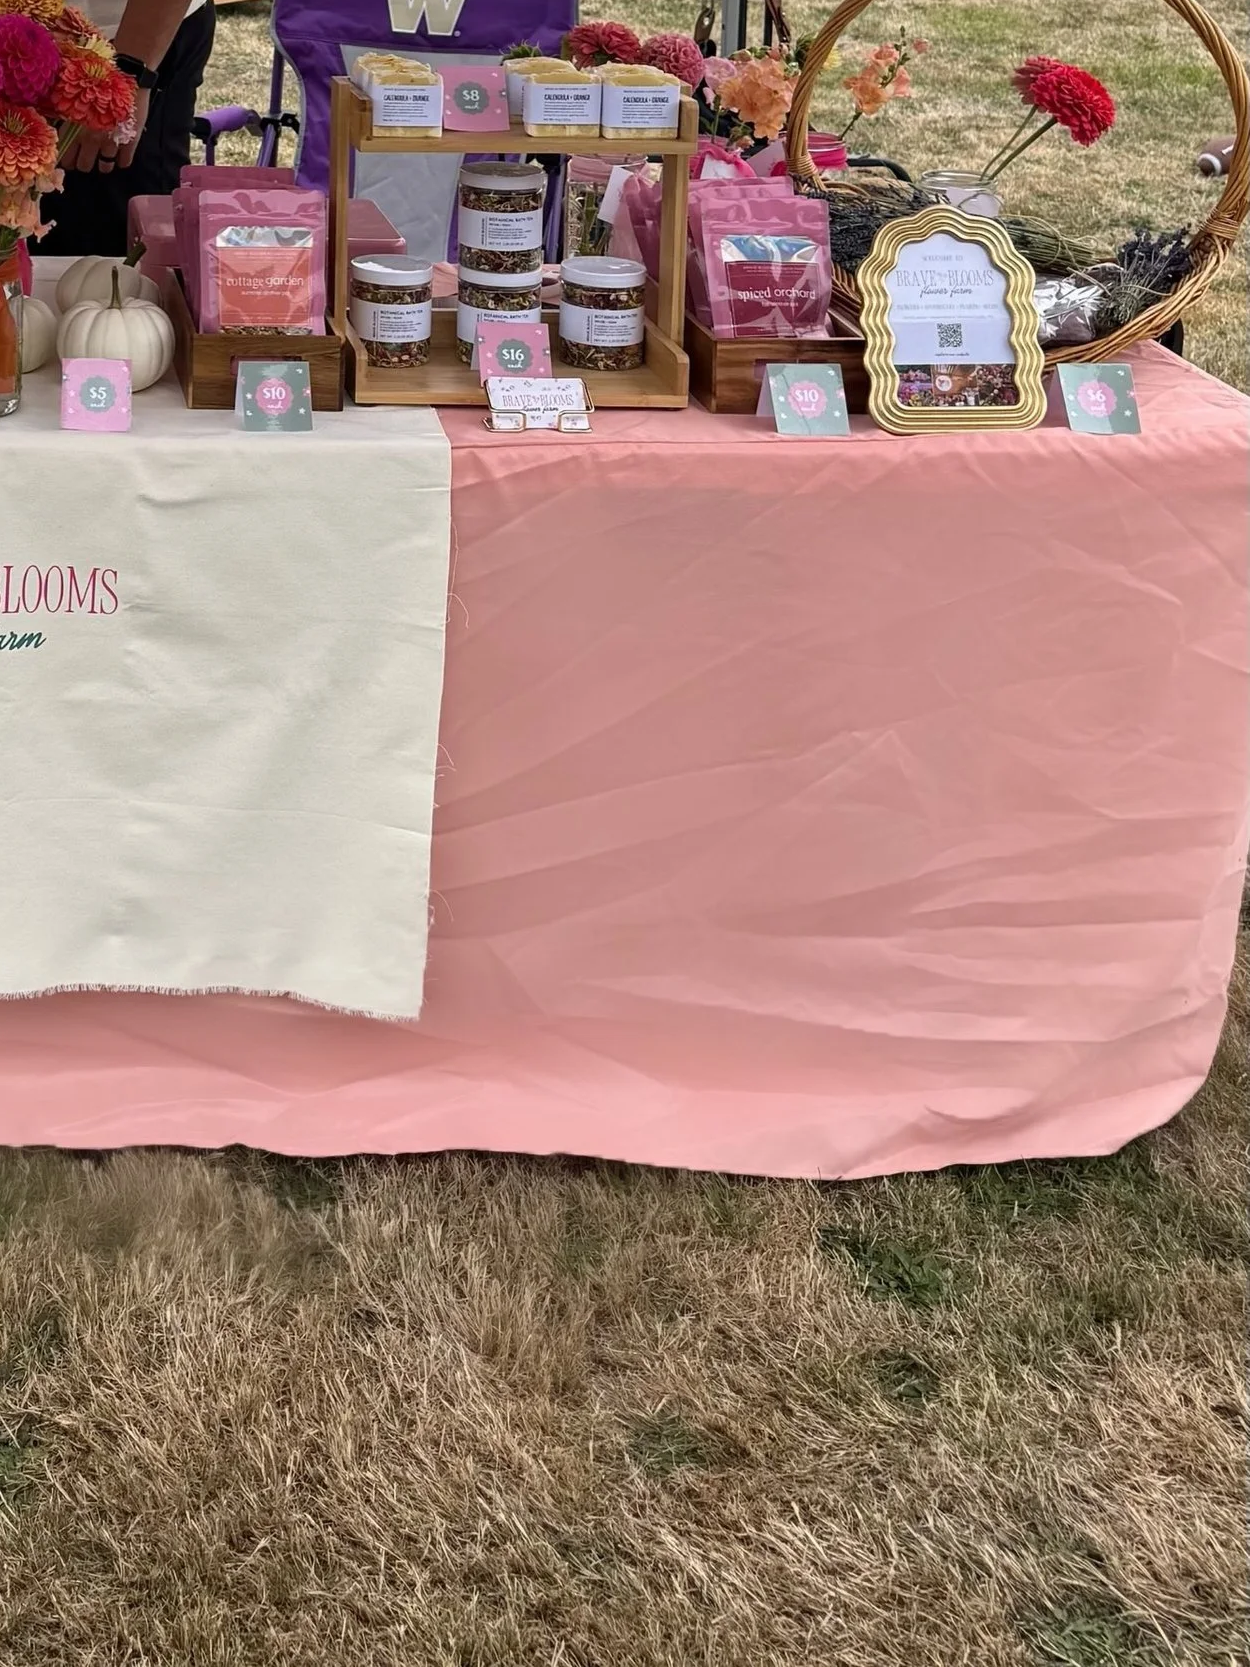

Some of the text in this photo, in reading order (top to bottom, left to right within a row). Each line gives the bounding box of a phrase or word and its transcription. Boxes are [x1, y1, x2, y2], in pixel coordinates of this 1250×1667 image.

[462, 89, 480, 101] $8
[622, 96, 649, 104] CALENDULA
[226, 276, 304, 289] cottage garden
[896, 269, 994, 287] BRAVE BLOOMS
[737, 286, 816, 302] spiced orchard
[920, 285, 973, 298] flower farm
[502, 348, 524, 361] $16
[89, 386, 107, 400] $5
[262, 386, 286, 400] $10
[794, 389, 819, 402] $10
[1086, 389, 1107, 402] $6
[502, 394, 575, 407] BRAVE BLOOMS
